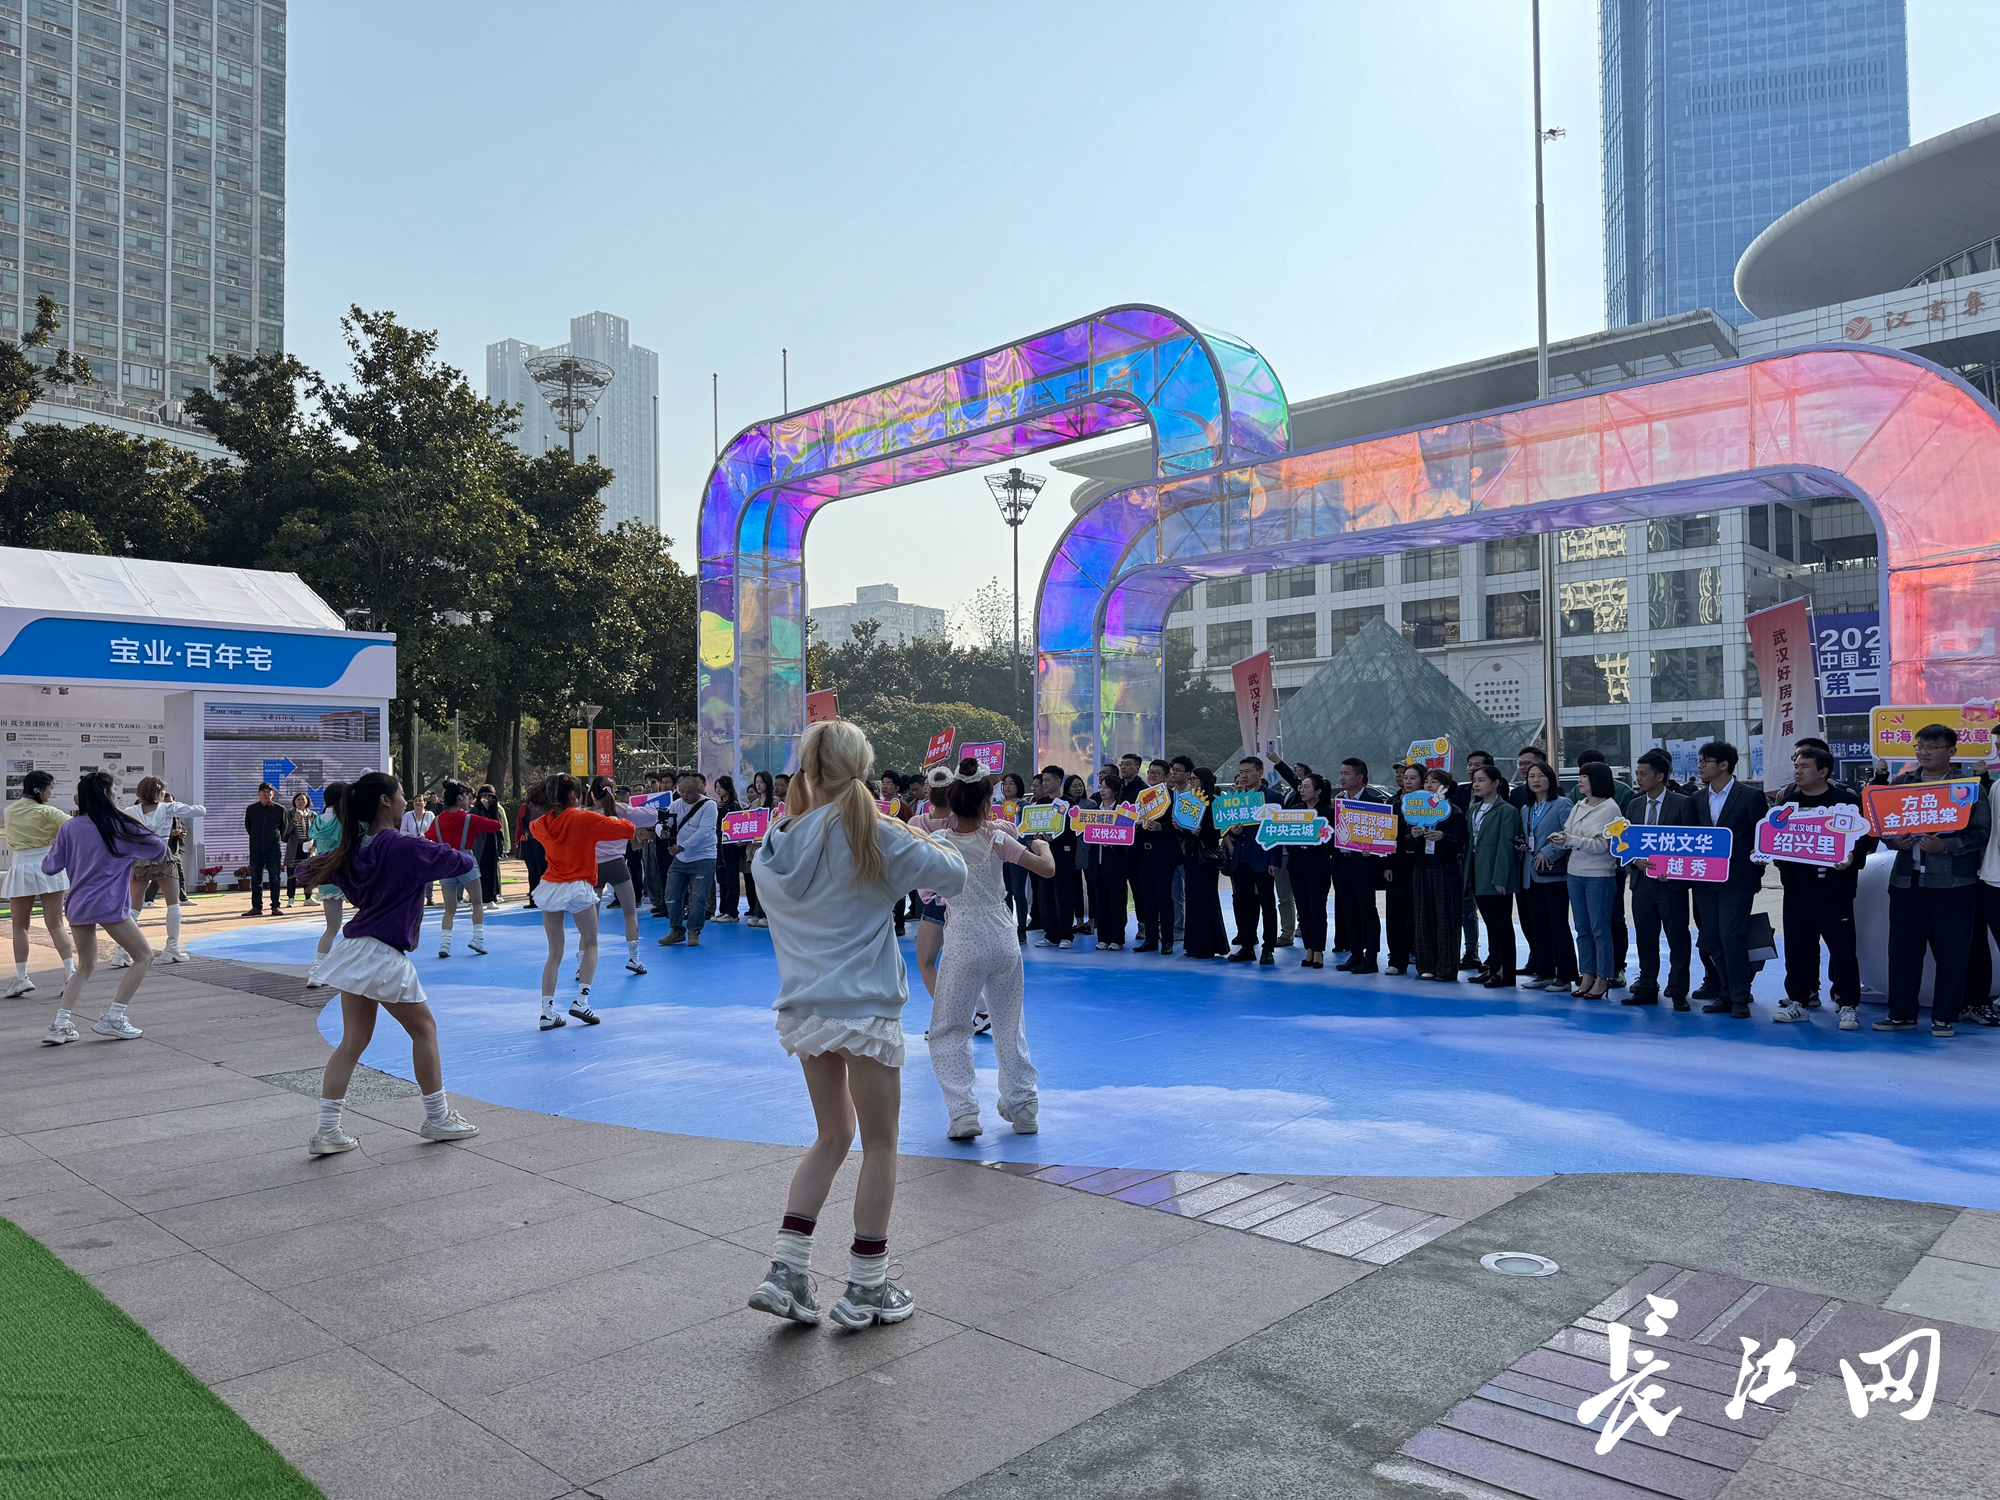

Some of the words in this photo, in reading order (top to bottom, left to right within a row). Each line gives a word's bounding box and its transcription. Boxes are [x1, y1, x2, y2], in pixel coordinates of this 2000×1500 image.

[1886, 291, 2000, 332] 汉商集
[109, 637, 272, 672] 宝业·百年宅
[1772, 628, 1795, 737] 武汉好房子展
[1880, 729, 1912, 744] 中海
[974, 747, 991, 758] 联投
[1412, 744, 1431, 758] 武汉
[1178, 796, 1201, 819] 方太
[1223, 797, 1249, 808] NO.1
[1901, 793, 1938, 811] 方岛
[1079, 813, 1114, 825] 武汉城建
[1277, 813, 1305, 821] 武汉城建
[1346, 811, 1393, 829] 招商武汉城建
[1406, 808, 1445, 817] 奥的斯机电
[1884, 807, 1958, 829] 金茂晓棠
[732, 820, 758, 834] 安居链
[1091, 827, 1127, 841] 汉悦公寓
[1265, 823, 1314, 837] 中央云城
[1353, 824, 1385, 840] 未来中心
[1788, 822, 1822, 834] 武汉城建
[1640, 832, 1713, 854] 天悦文华
[1773, 832, 1836, 856] 绍兴里
[1666, 857, 1707, 877] 越秀
